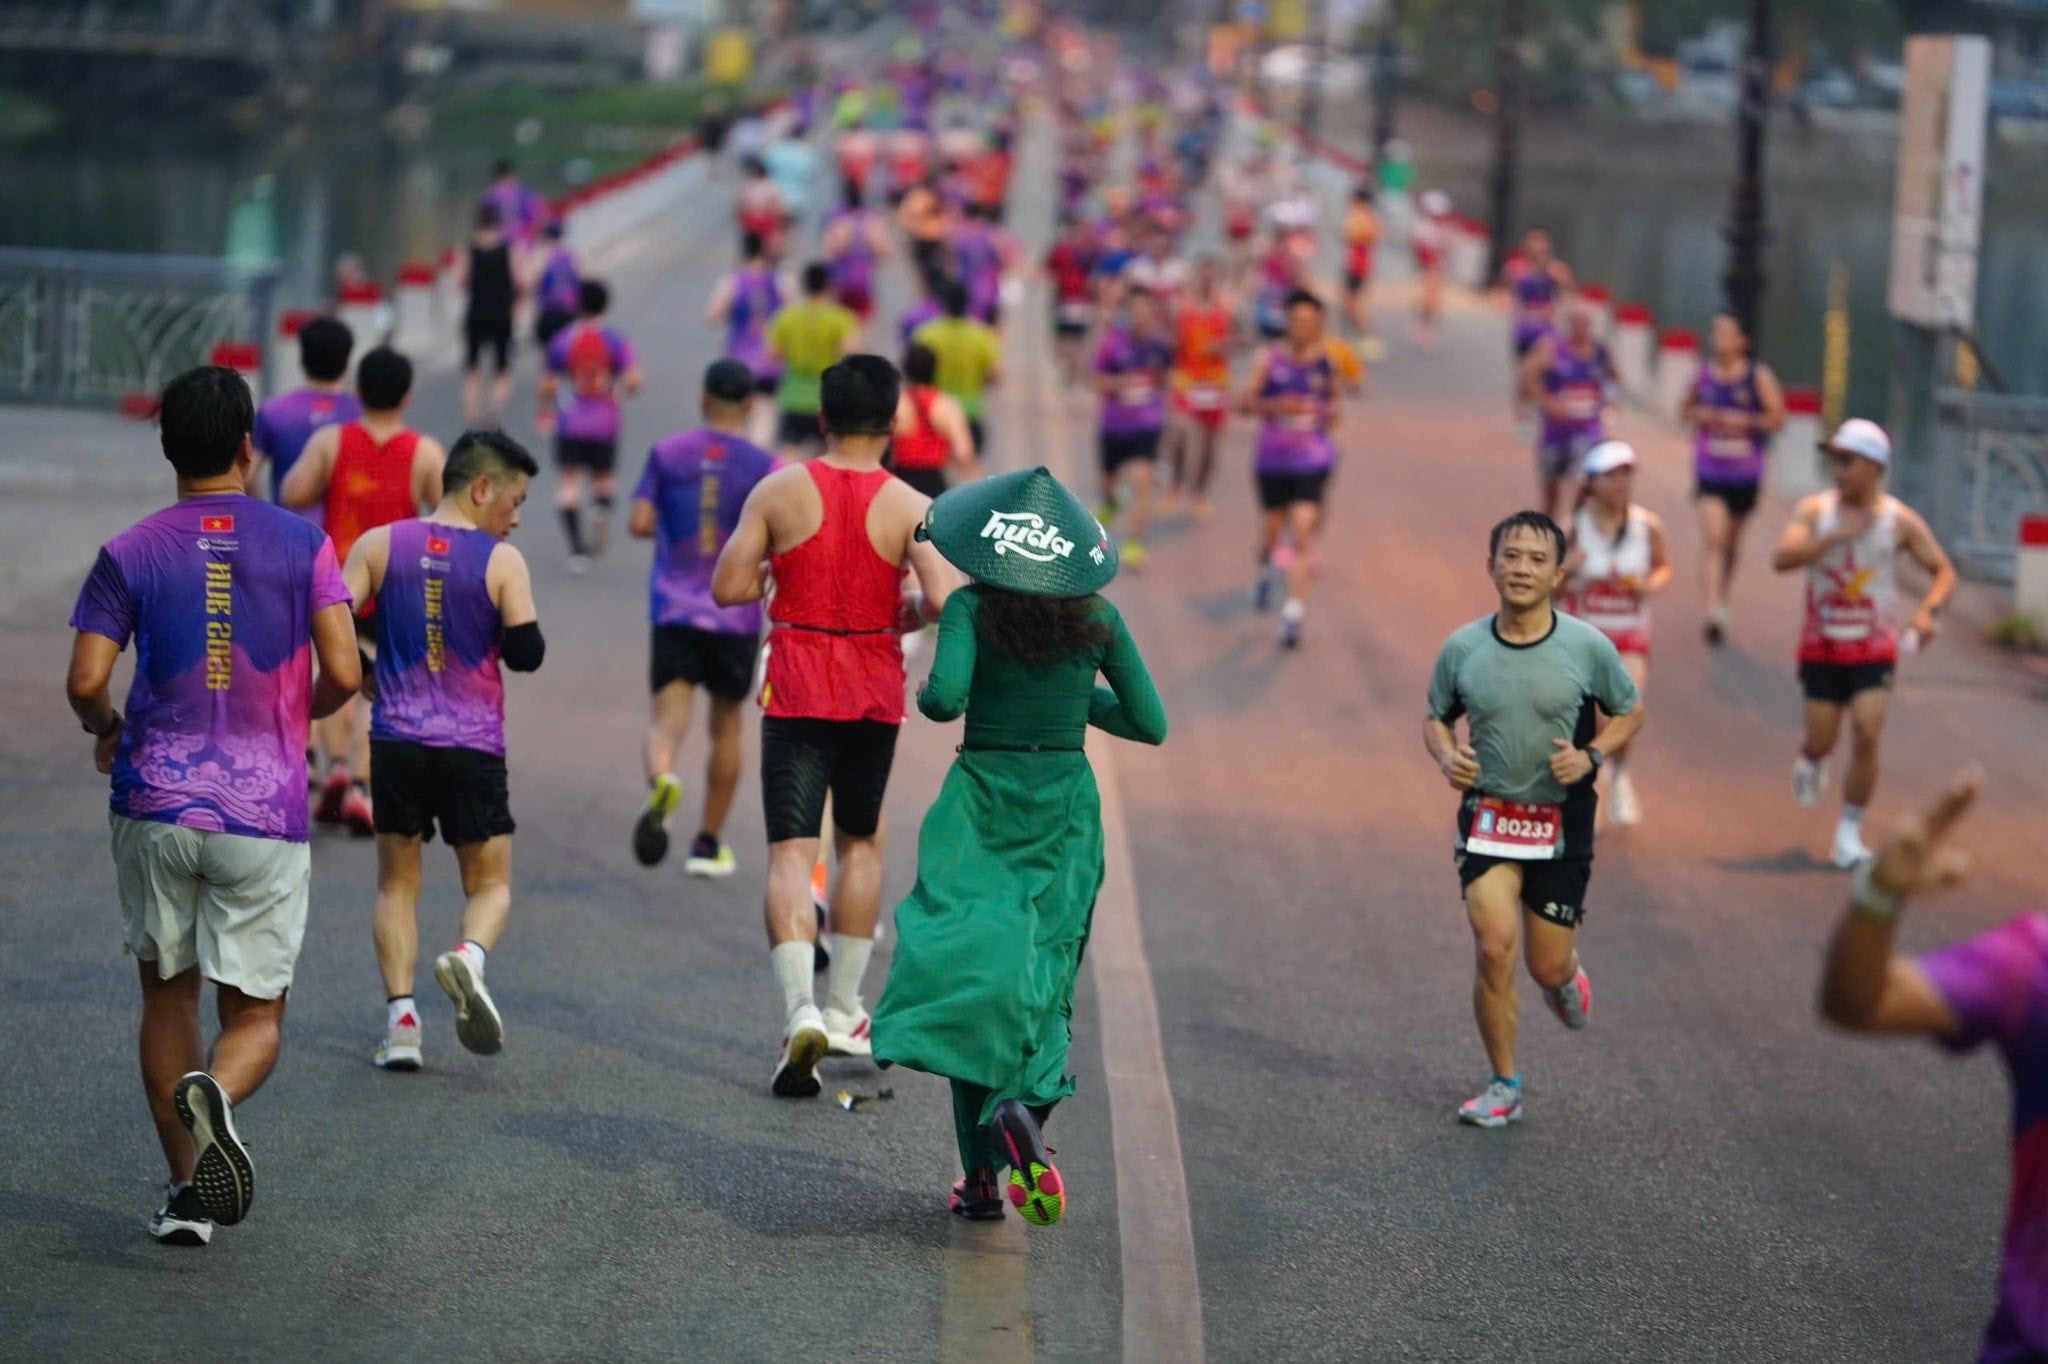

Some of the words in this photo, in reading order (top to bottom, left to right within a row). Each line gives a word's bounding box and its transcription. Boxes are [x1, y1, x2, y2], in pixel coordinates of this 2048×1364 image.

[980, 509, 1076, 562] huda
[206, 621, 232, 690] 2026
[1496, 816, 1555, 839] 80233
